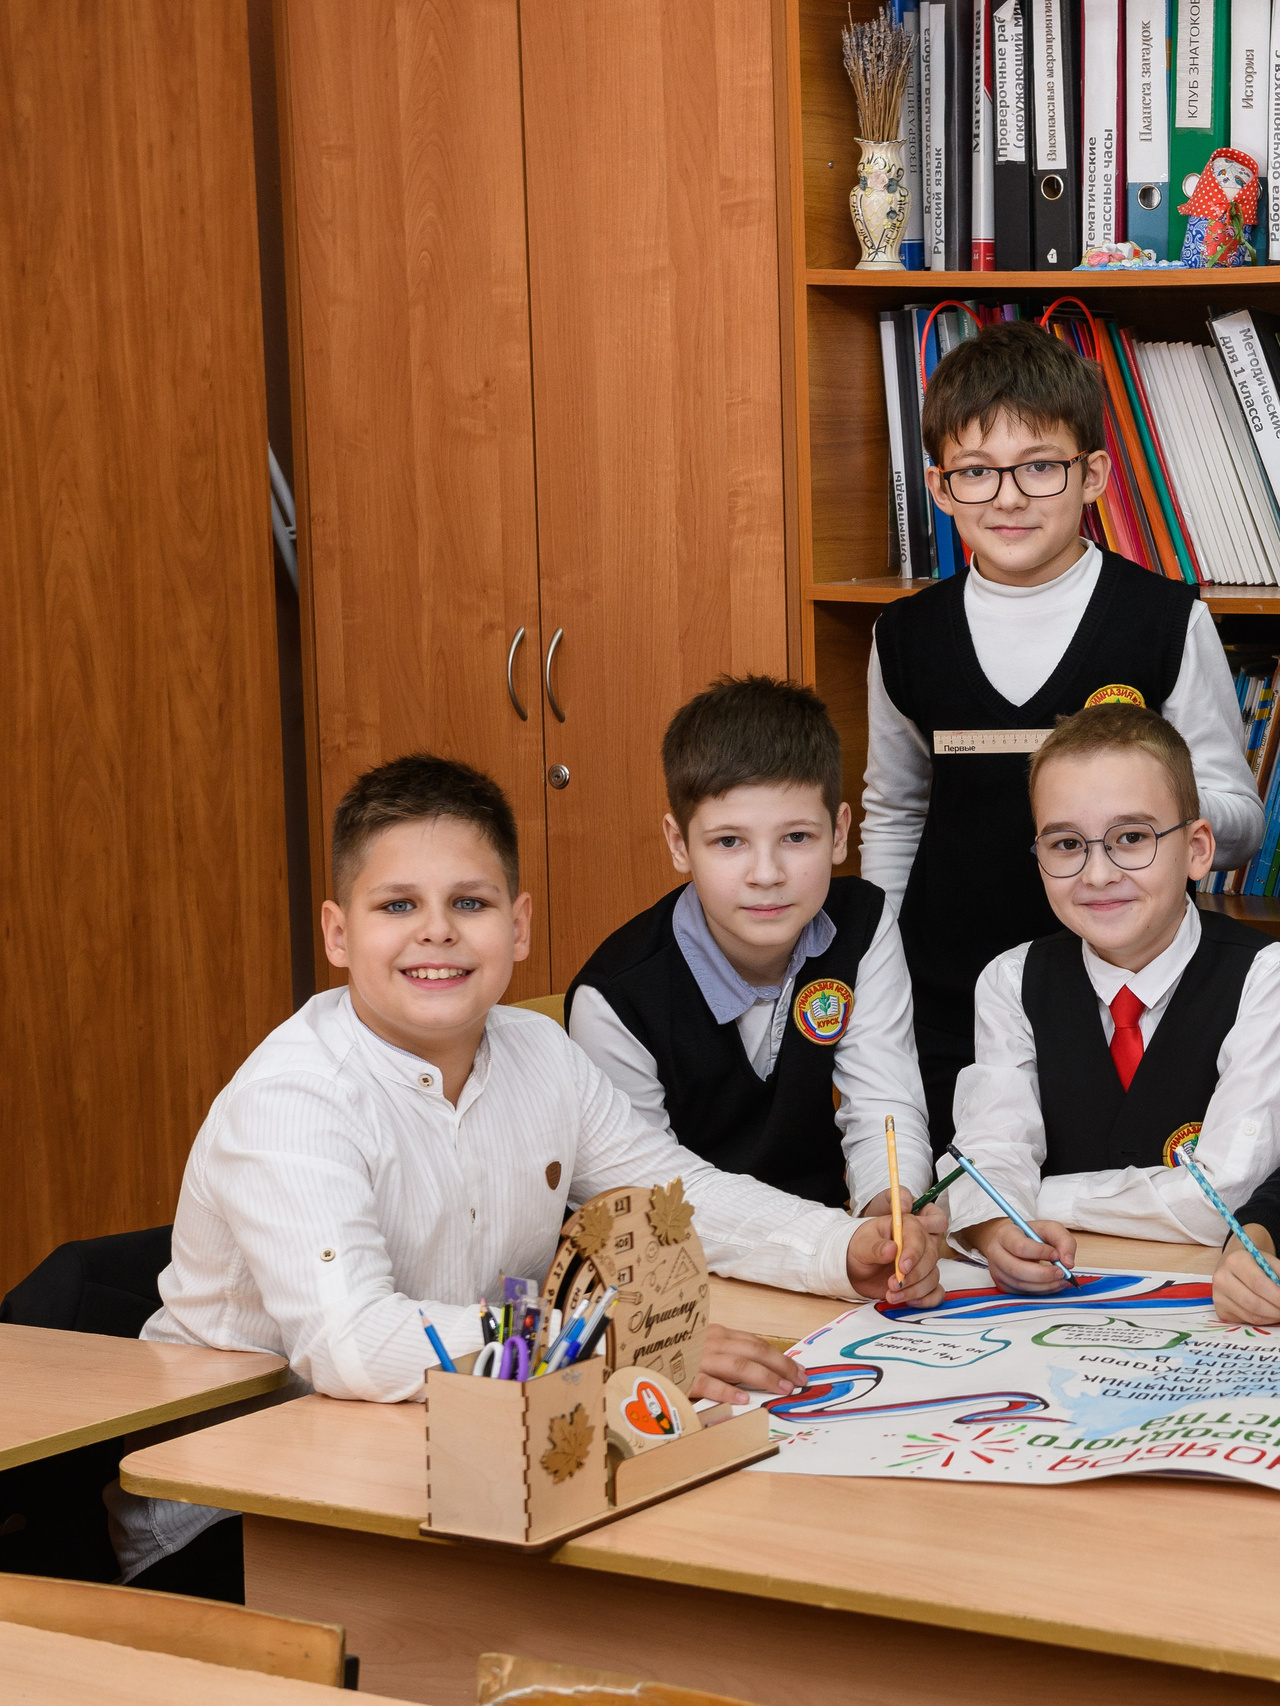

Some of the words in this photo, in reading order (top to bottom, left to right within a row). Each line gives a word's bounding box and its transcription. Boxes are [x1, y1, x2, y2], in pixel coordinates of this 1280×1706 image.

[1045, 0, 1056, 78] мероприятия
[1141, 20, 1154, 78] загадок
[1188, 0, 1200, 76] ЗНАТОКОВ
[972, 10, 981, 153] Математика
[997, 48, 1009, 158] Проверочные
[1187, 81, 1198, 118] КЛУБ
[1242, 49, 1257, 110] История
[1046, 81, 1057, 162] Внеклассные
[1138, 82, 1152, 143] Планета
[933, 148, 942, 186] язык
[1104, 128, 1114, 168] часы
[1086, 136, 1097, 250] Тематические
[1102, 173, 1113, 242] лассные
[1270, 187, 1280, 242] Работа
[933, 191, 944, 255] Русский
[1220, 335, 1239, 364] для
[1234, 367, 1246, 378] 1
[1238, 380, 1264, 433] класса
[895, 470, 908, 564] Олимпиады
[944, 744, 976, 753] Первые
[799, 982, 834, 1010] ГИМНАЗИЯ
[817, 1017, 839, 1028] КУРСК
[628, 1300, 698, 1338] Лучшему
[634, 1312, 699, 1366] учителю!
[1084, 1374, 1210, 1392] ПАМЯТНИК
[1155, 1355, 1171, 1364] В
[1102, 1388, 1252, 1402] НАРОДНОГО
